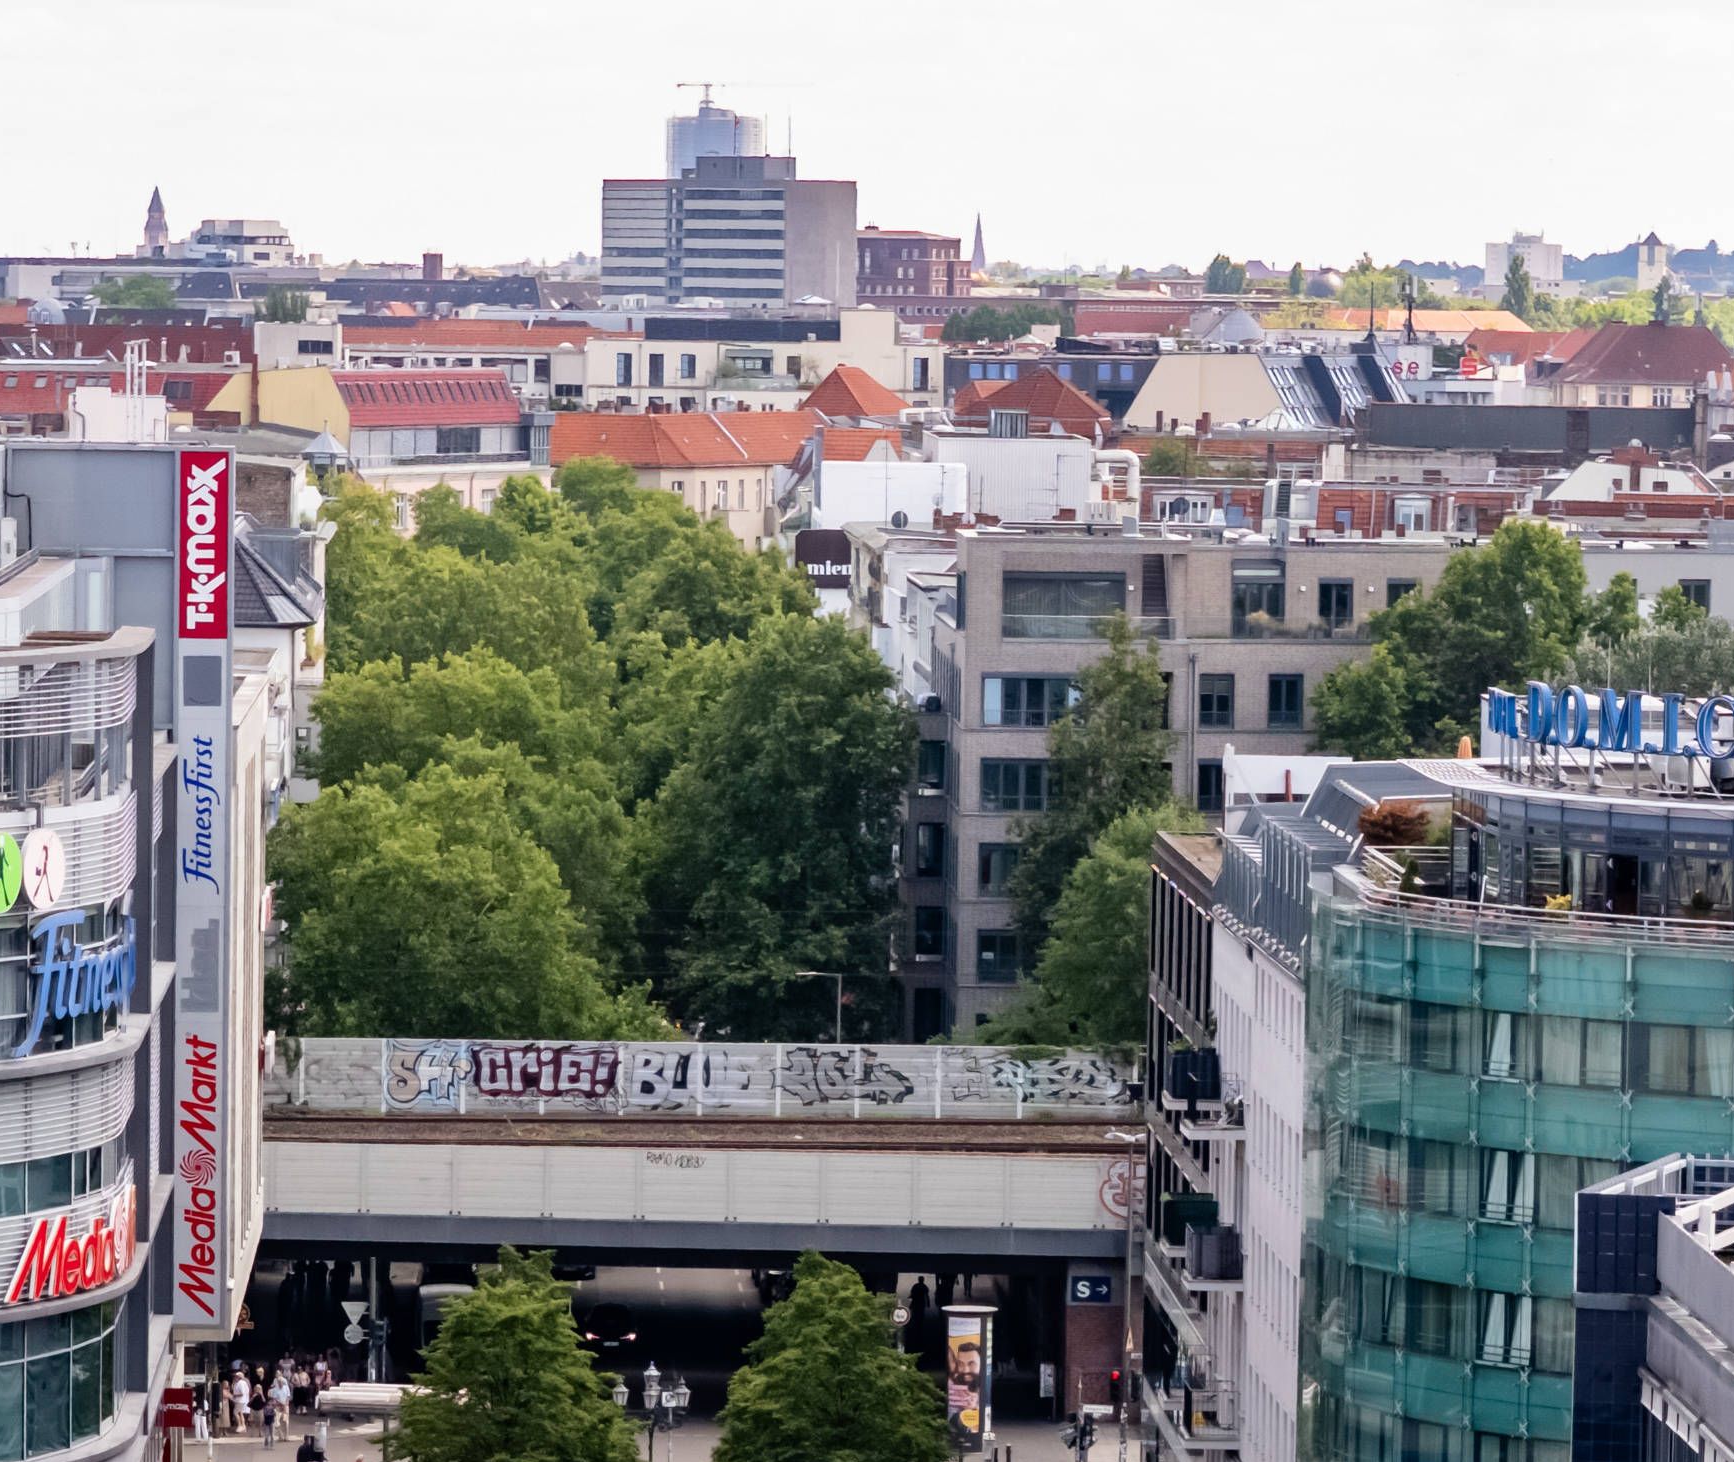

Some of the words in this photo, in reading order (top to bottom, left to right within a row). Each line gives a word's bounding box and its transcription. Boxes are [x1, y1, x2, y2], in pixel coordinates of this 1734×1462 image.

[179, 1034, 217, 1155] Markt
[4, 1214, 115, 1304] Media
[179, 1186, 216, 1317] Media
[1076, 1281, 1091, 1298] S
